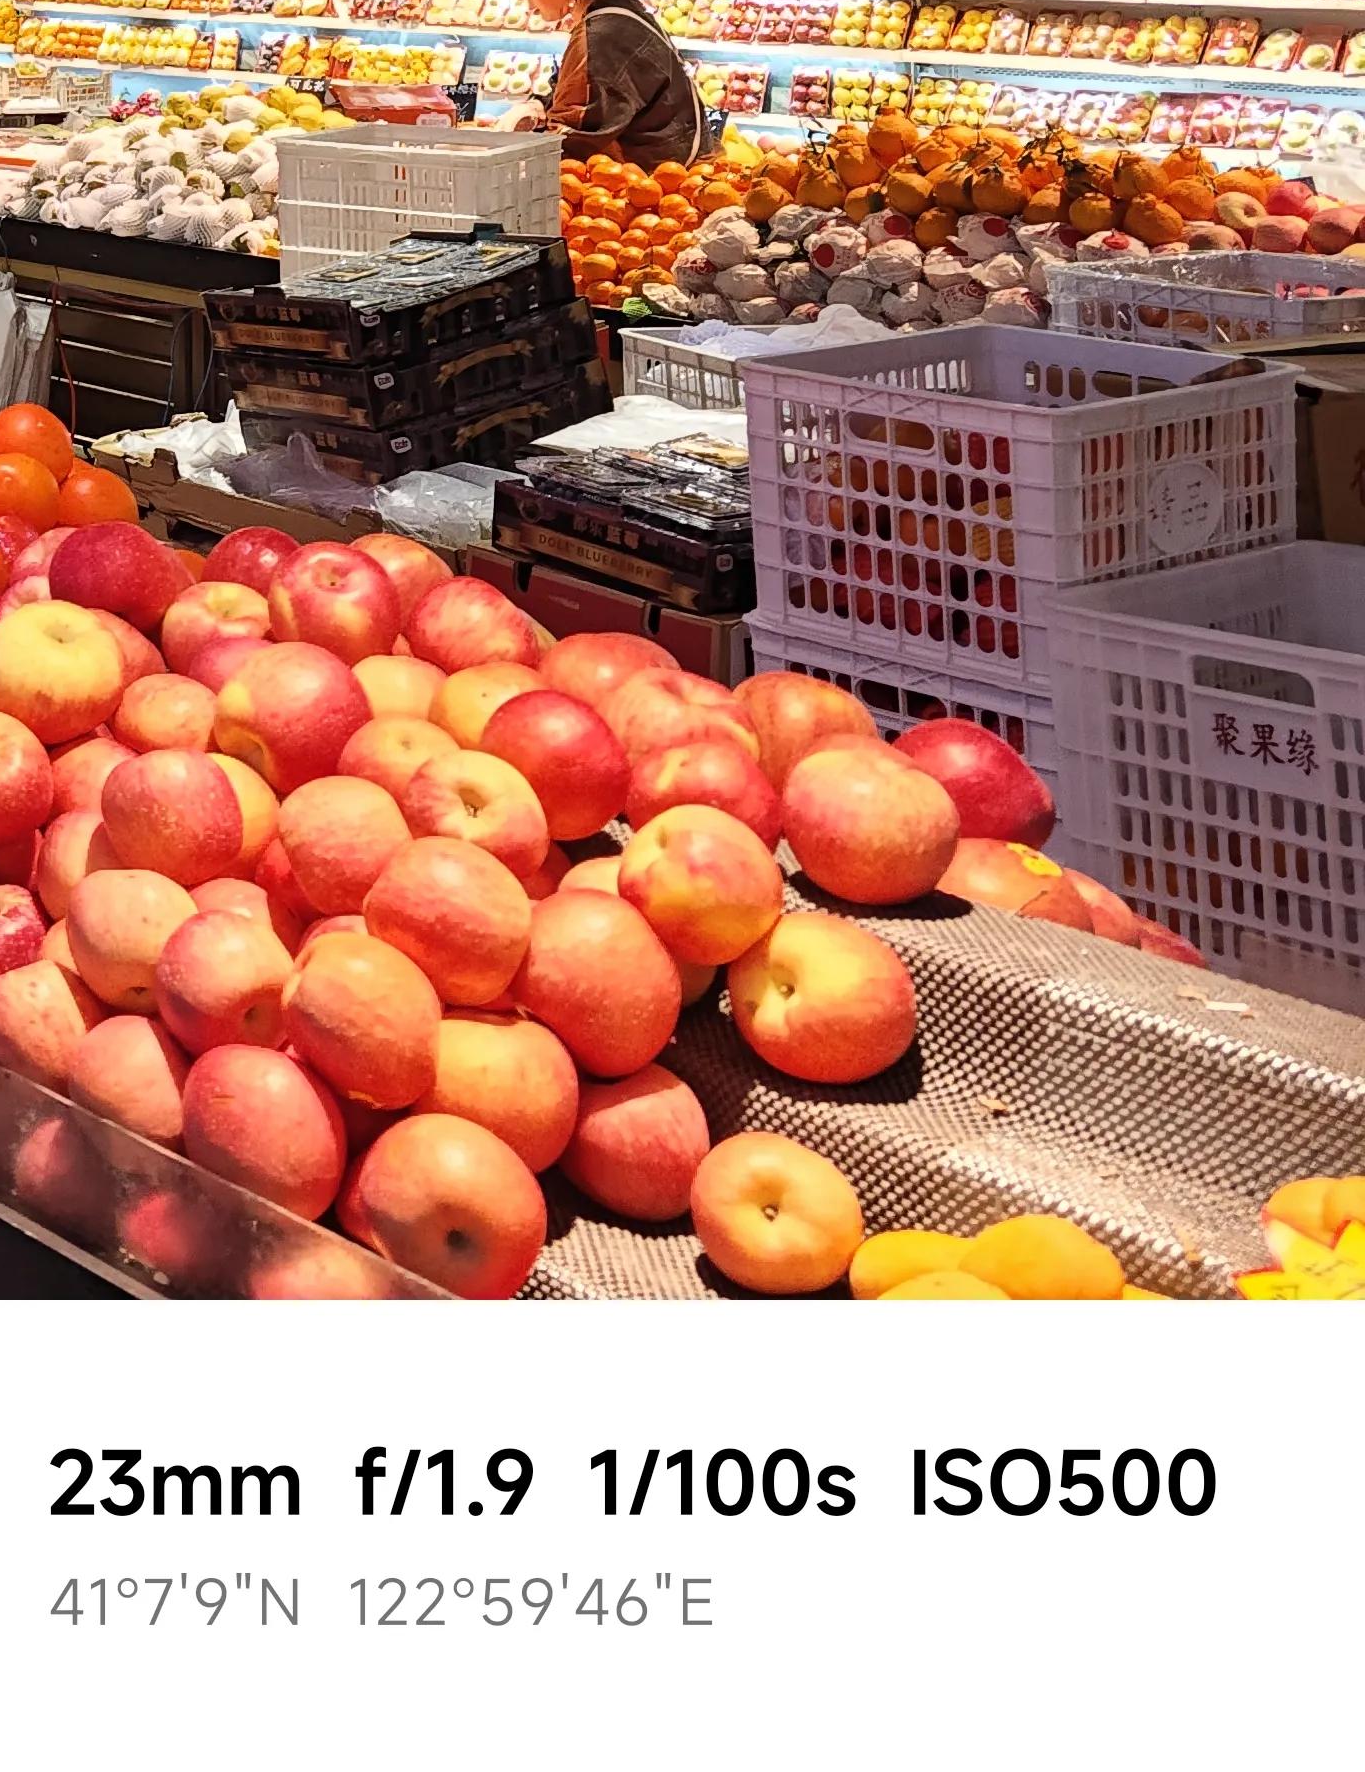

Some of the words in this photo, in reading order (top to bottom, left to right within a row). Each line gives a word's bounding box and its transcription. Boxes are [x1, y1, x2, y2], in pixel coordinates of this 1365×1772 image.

[538, 532, 573, 551] DOLE
[576, 545, 654, 578] BLUEBERRY
[1211, 712, 1320, 776] 聚果缘
